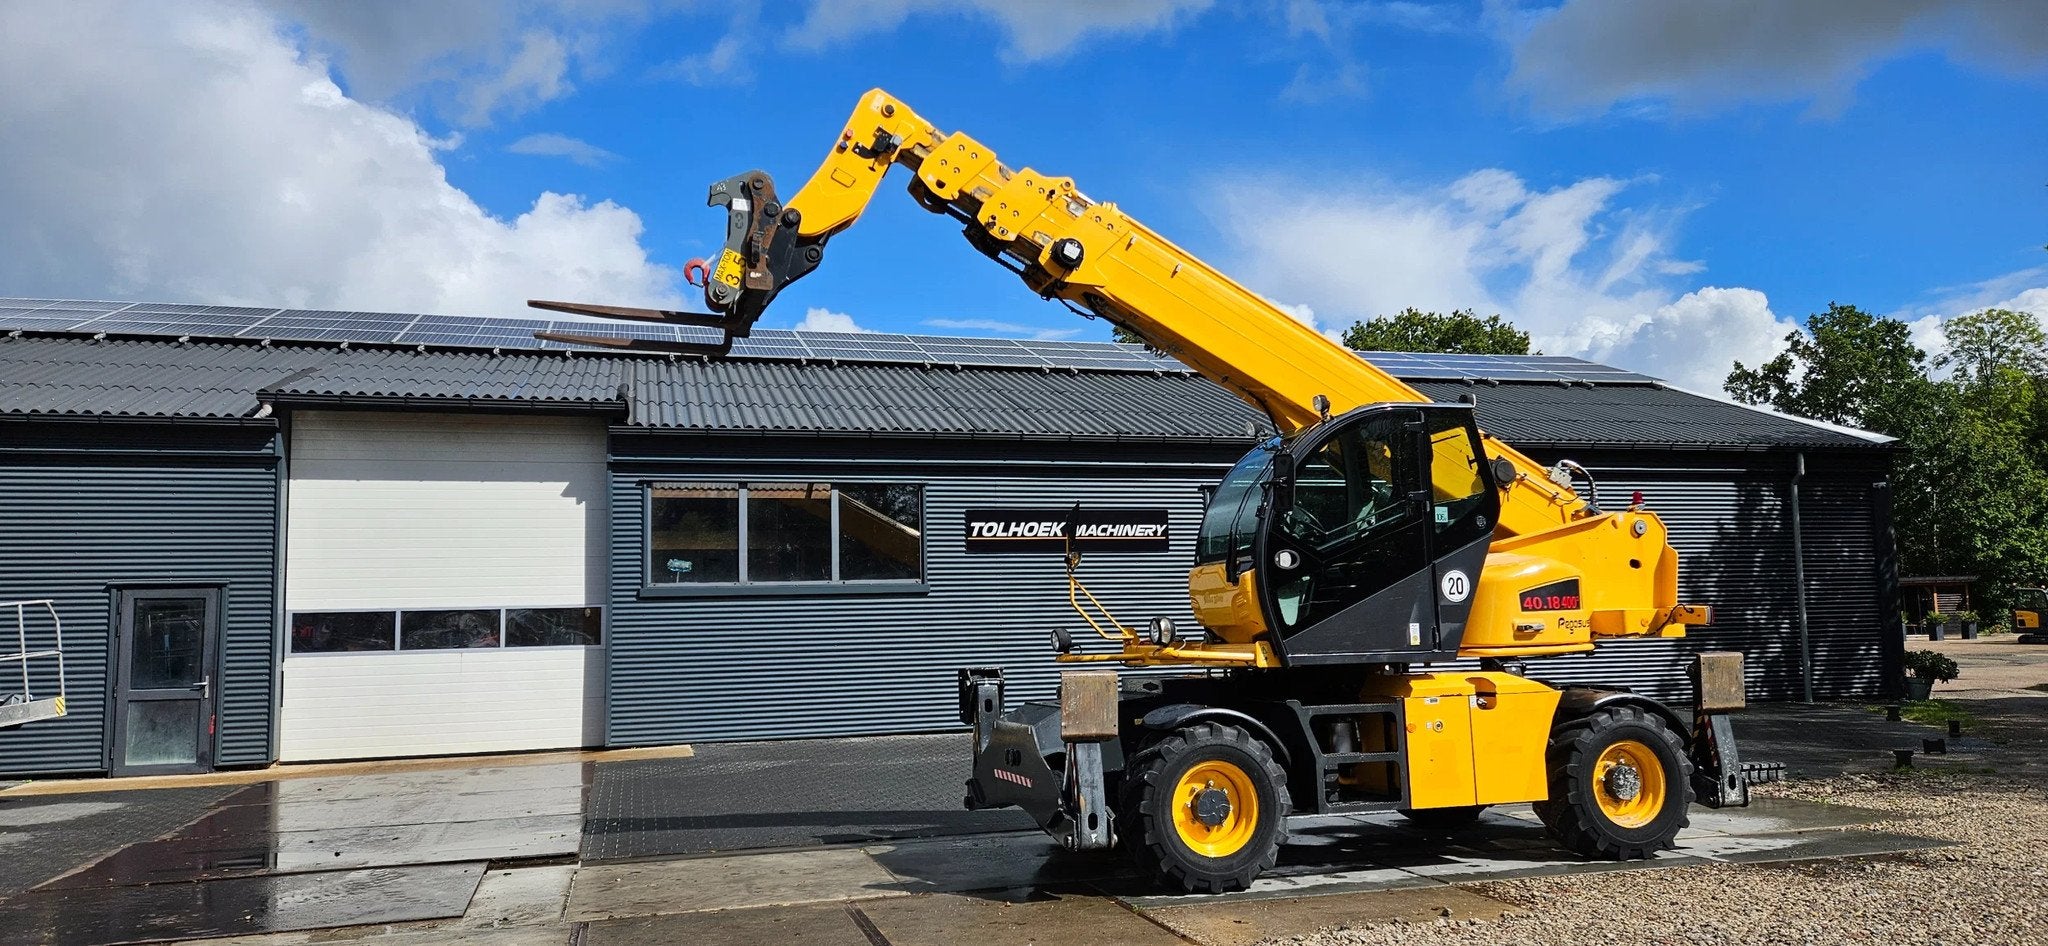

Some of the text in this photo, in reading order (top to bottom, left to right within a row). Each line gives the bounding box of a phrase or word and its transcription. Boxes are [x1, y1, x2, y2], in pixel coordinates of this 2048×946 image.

[714, 249, 733, 281] MAX-TON
[970, 521, 1066, 537] TOLHOEK
[1448, 577, 1464, 596] 20
[1523, 596, 1560, 610] 40.18
[1558, 617, 1591, 635] Pegasus
